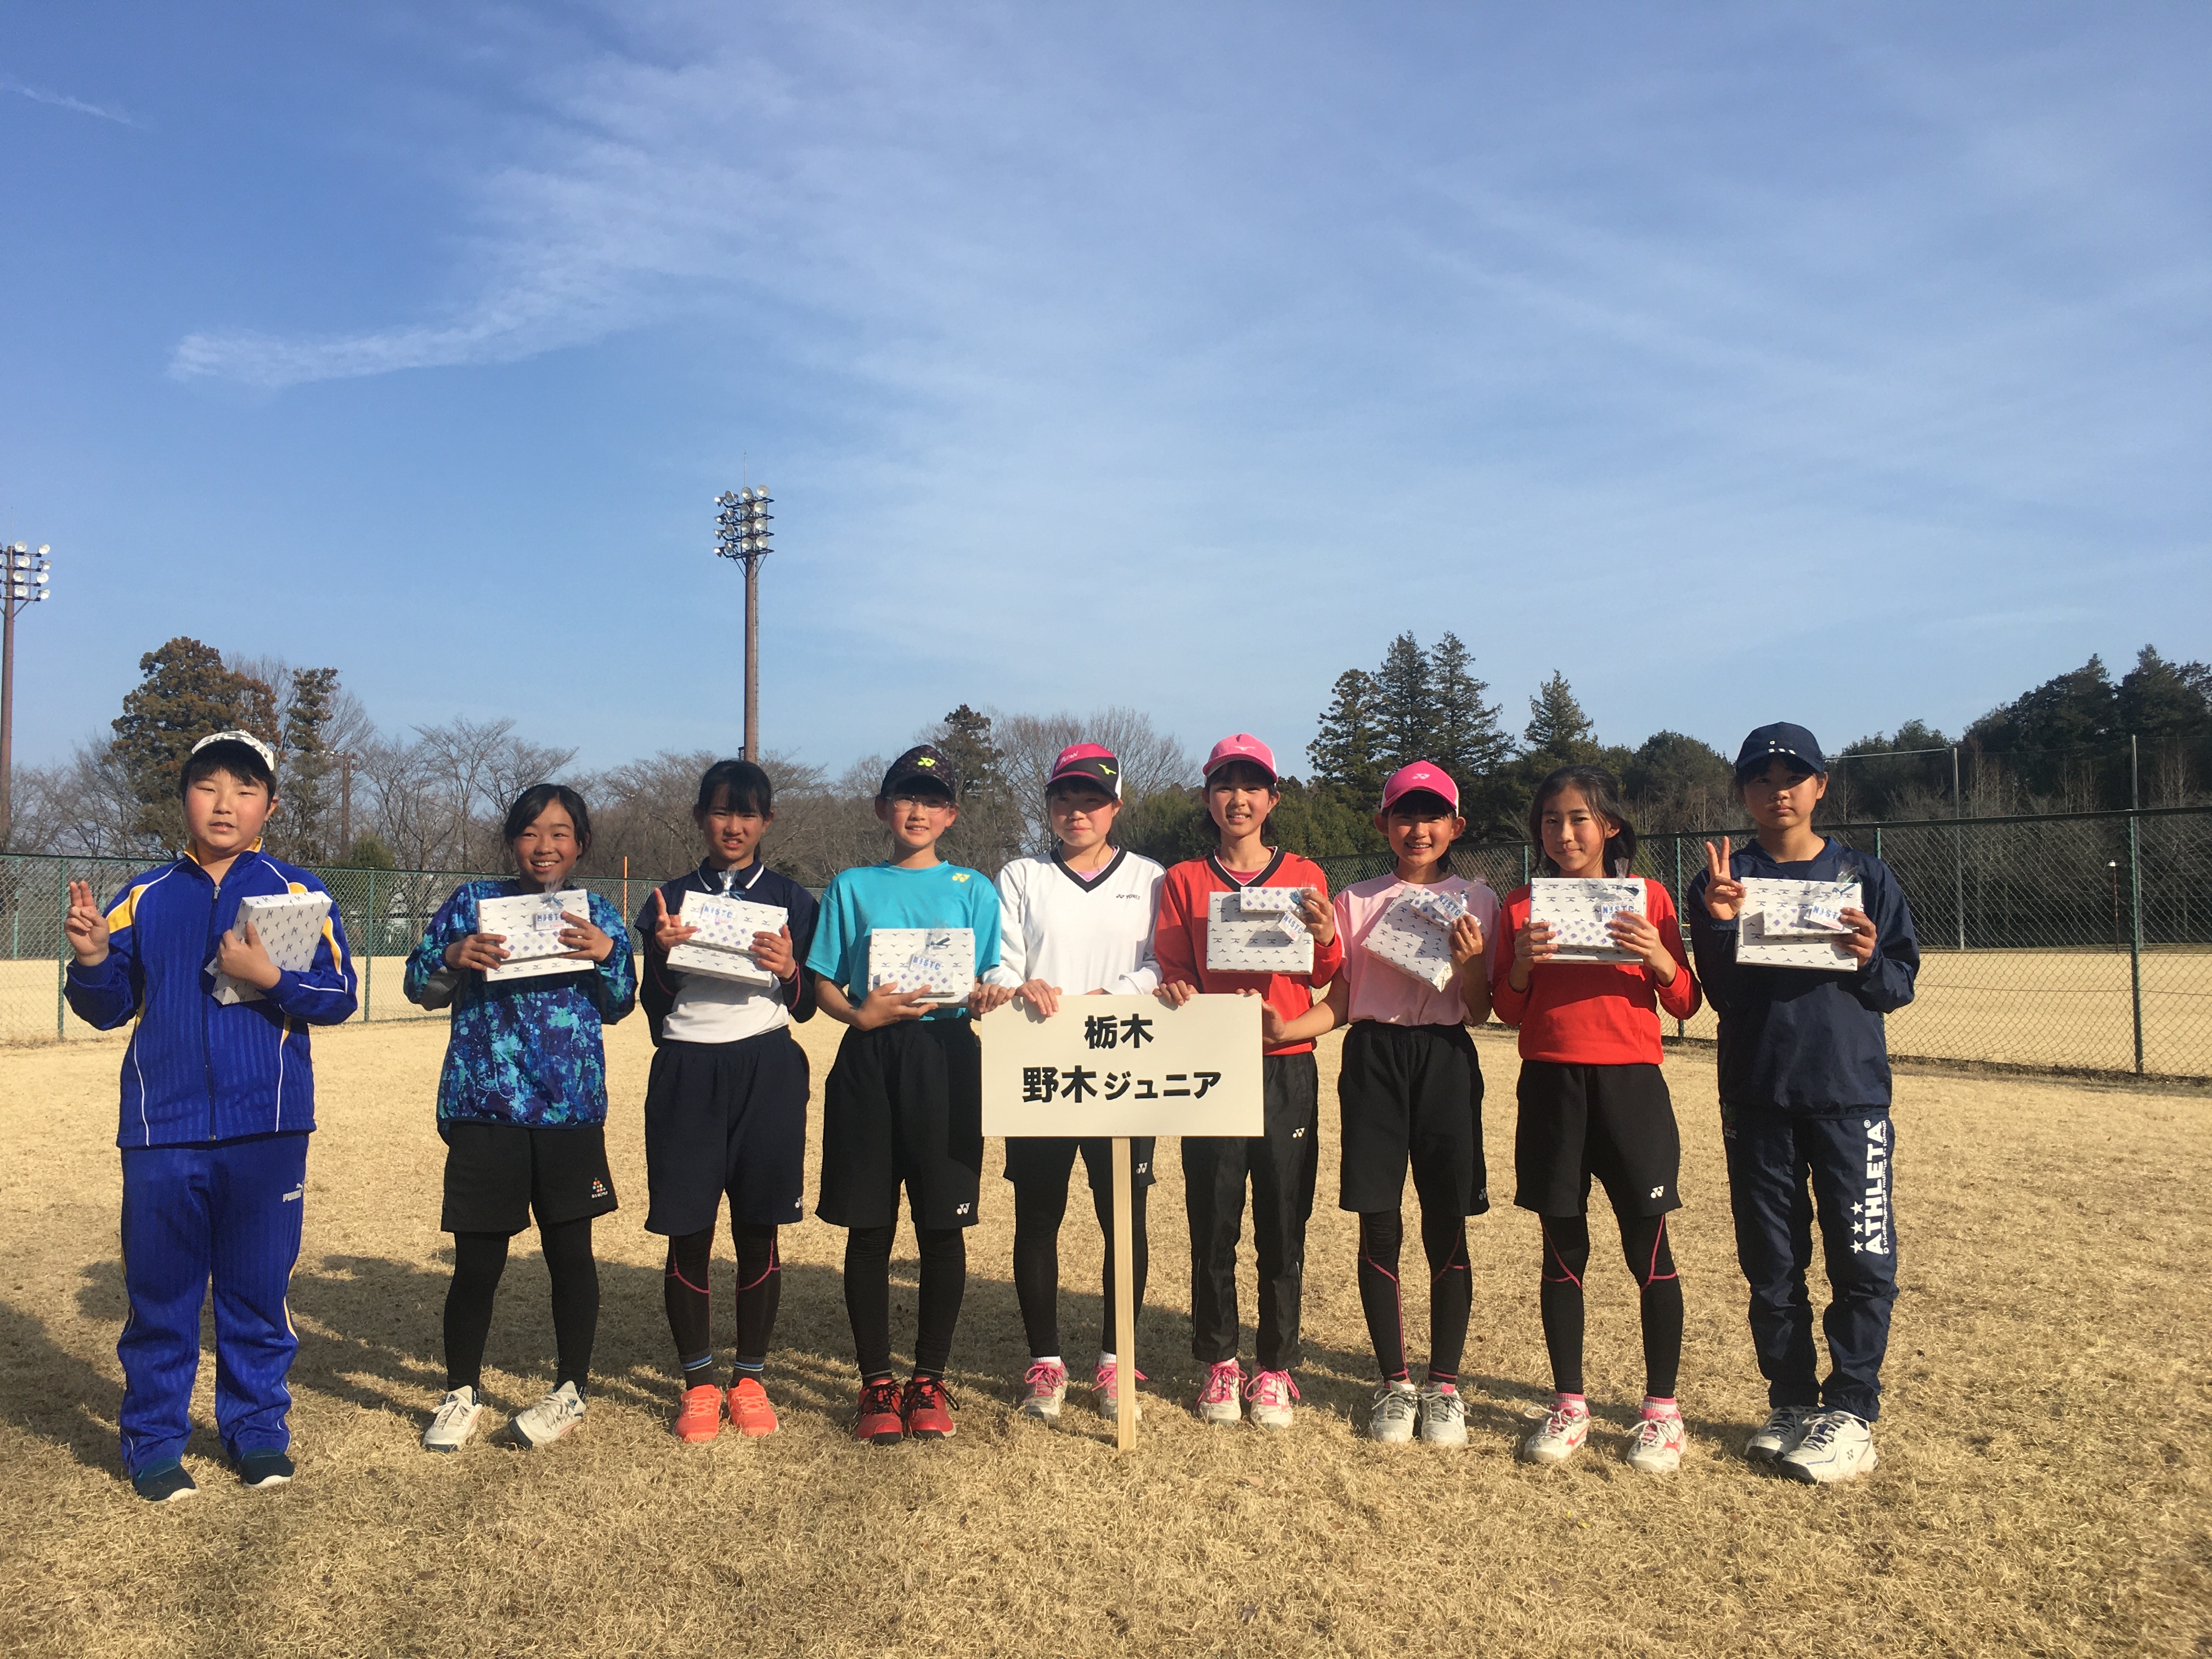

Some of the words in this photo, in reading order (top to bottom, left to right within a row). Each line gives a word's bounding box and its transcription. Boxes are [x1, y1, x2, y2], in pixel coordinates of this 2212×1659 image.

[1084, 1013, 1154, 1049] 栃木
[1022, 1065, 1222, 1103] 野木ジュニア
[1865, 1121, 1884, 1255] ATHLETA
